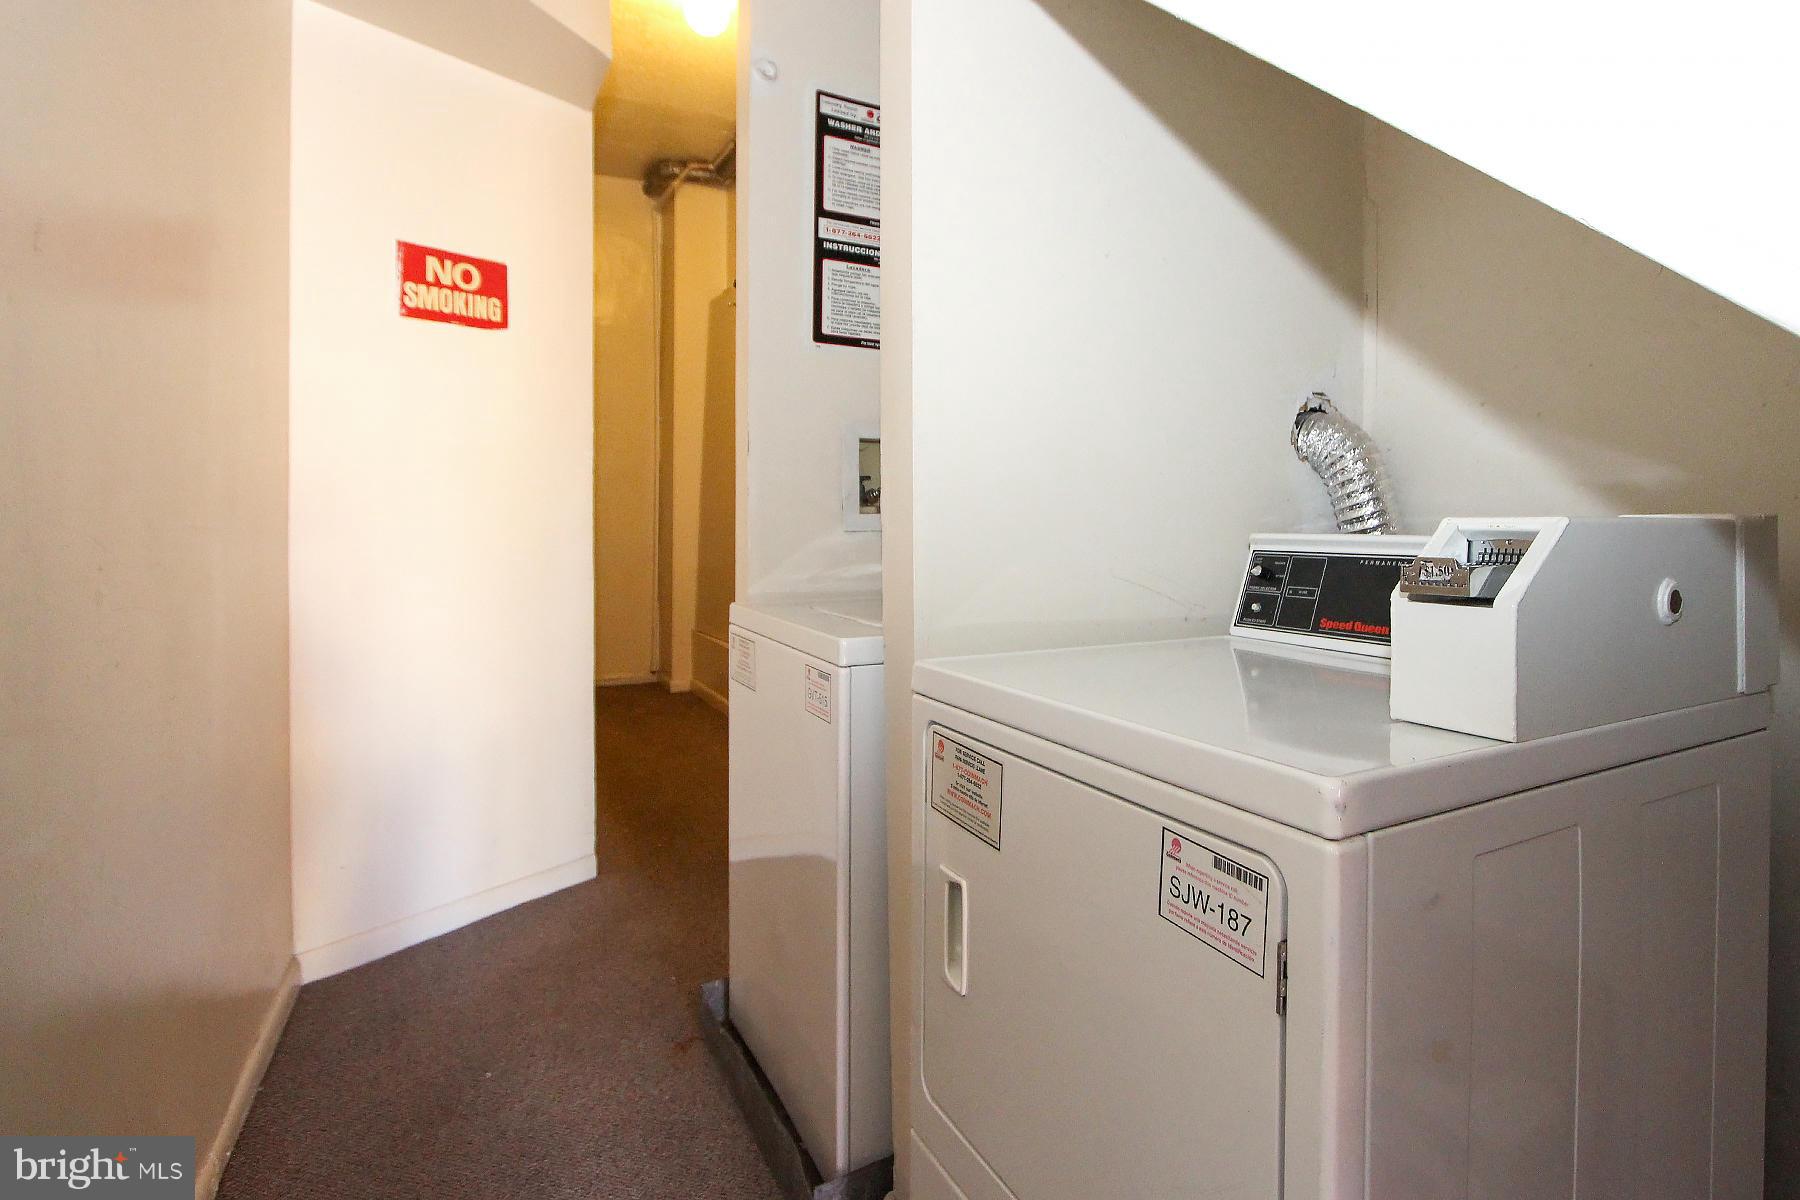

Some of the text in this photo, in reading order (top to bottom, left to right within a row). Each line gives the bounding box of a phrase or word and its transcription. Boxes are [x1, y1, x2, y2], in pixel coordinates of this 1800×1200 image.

[827, 117, 863, 133] WASHER
[425, 255, 481, 291] NO
[402, 281, 502, 323] SMOKING
[1424, 564, 1451, 579] $1.50
[1319, 616, 1390, 635] Speed Queen
[1169, 875, 1252, 937] SJW-187
